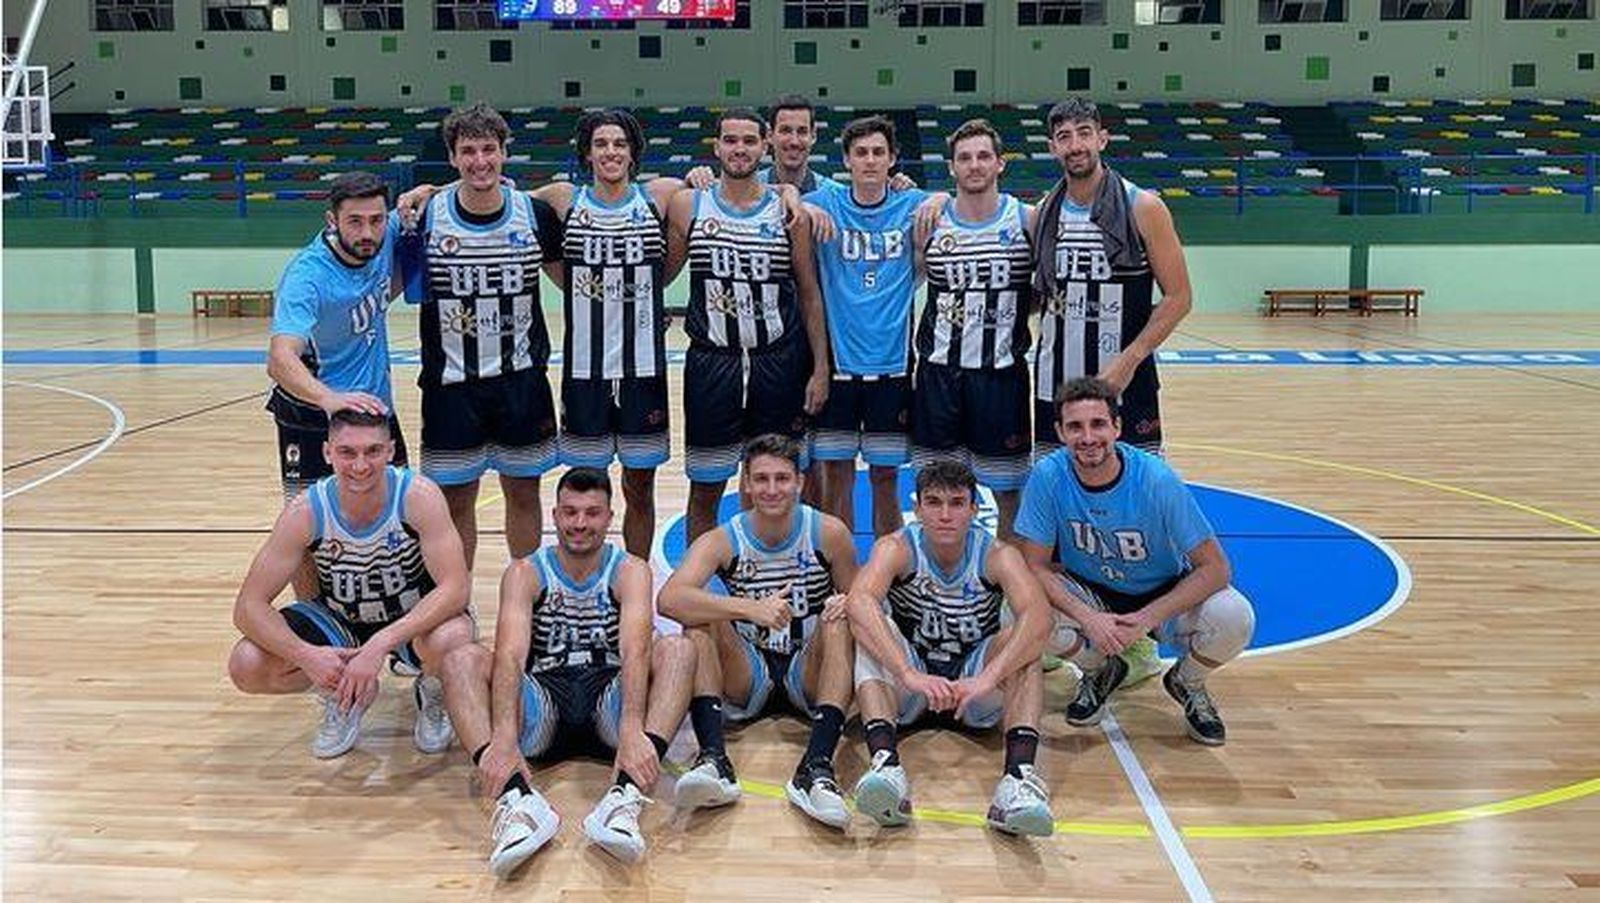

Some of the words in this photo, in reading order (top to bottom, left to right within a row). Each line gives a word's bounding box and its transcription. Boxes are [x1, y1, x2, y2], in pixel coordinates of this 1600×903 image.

[656, 0, 682, 14] 49
[583, 236, 645, 265] ULB
[842, 224, 904, 260] ULB
[710, 247, 771, 281] ULB
[863, 271, 876, 288] 5
[944, 260, 1012, 290] ULB
[447, 264, 525, 296] ULB
[1157, 351, 1275, 362] La
[330, 564, 407, 603] ULB
[919, 608, 982, 643] ULB
